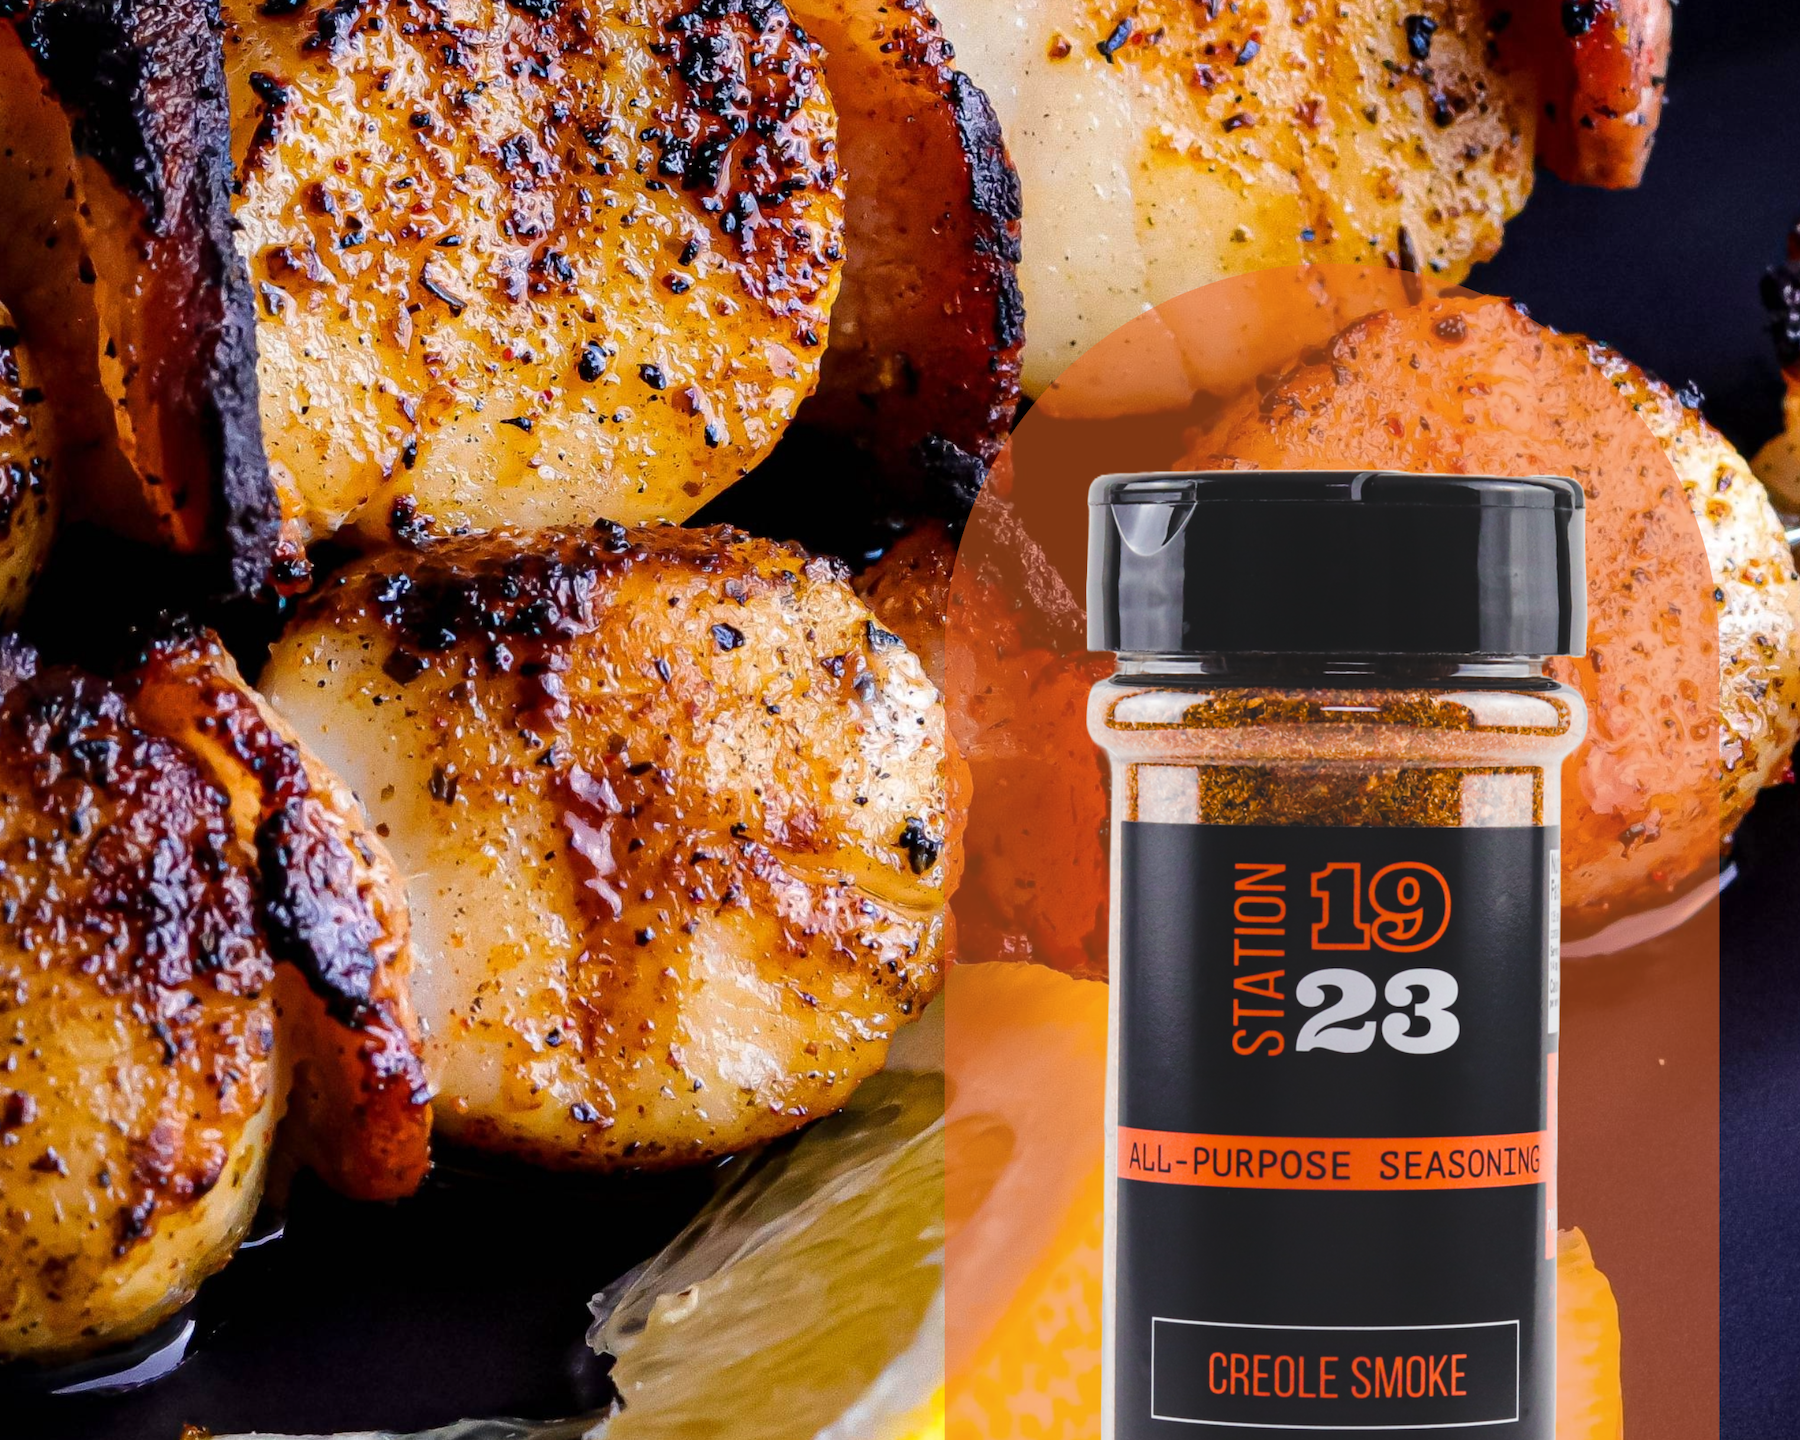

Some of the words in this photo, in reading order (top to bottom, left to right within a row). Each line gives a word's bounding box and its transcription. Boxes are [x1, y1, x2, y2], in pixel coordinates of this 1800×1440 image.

[1310, 861, 1451, 953] 19
[1232, 862, 1287, 1057] STATION
[1295, 967, 1460, 1055] 23
[1129, 1141, 1351, 1181] ALL-PURPOSE
[1379, 1144, 1541, 1181] SEASONING
[1208, 1351, 1339, 1399] CREOLE
[1350, 1353, 1468, 1399] SMOKE
